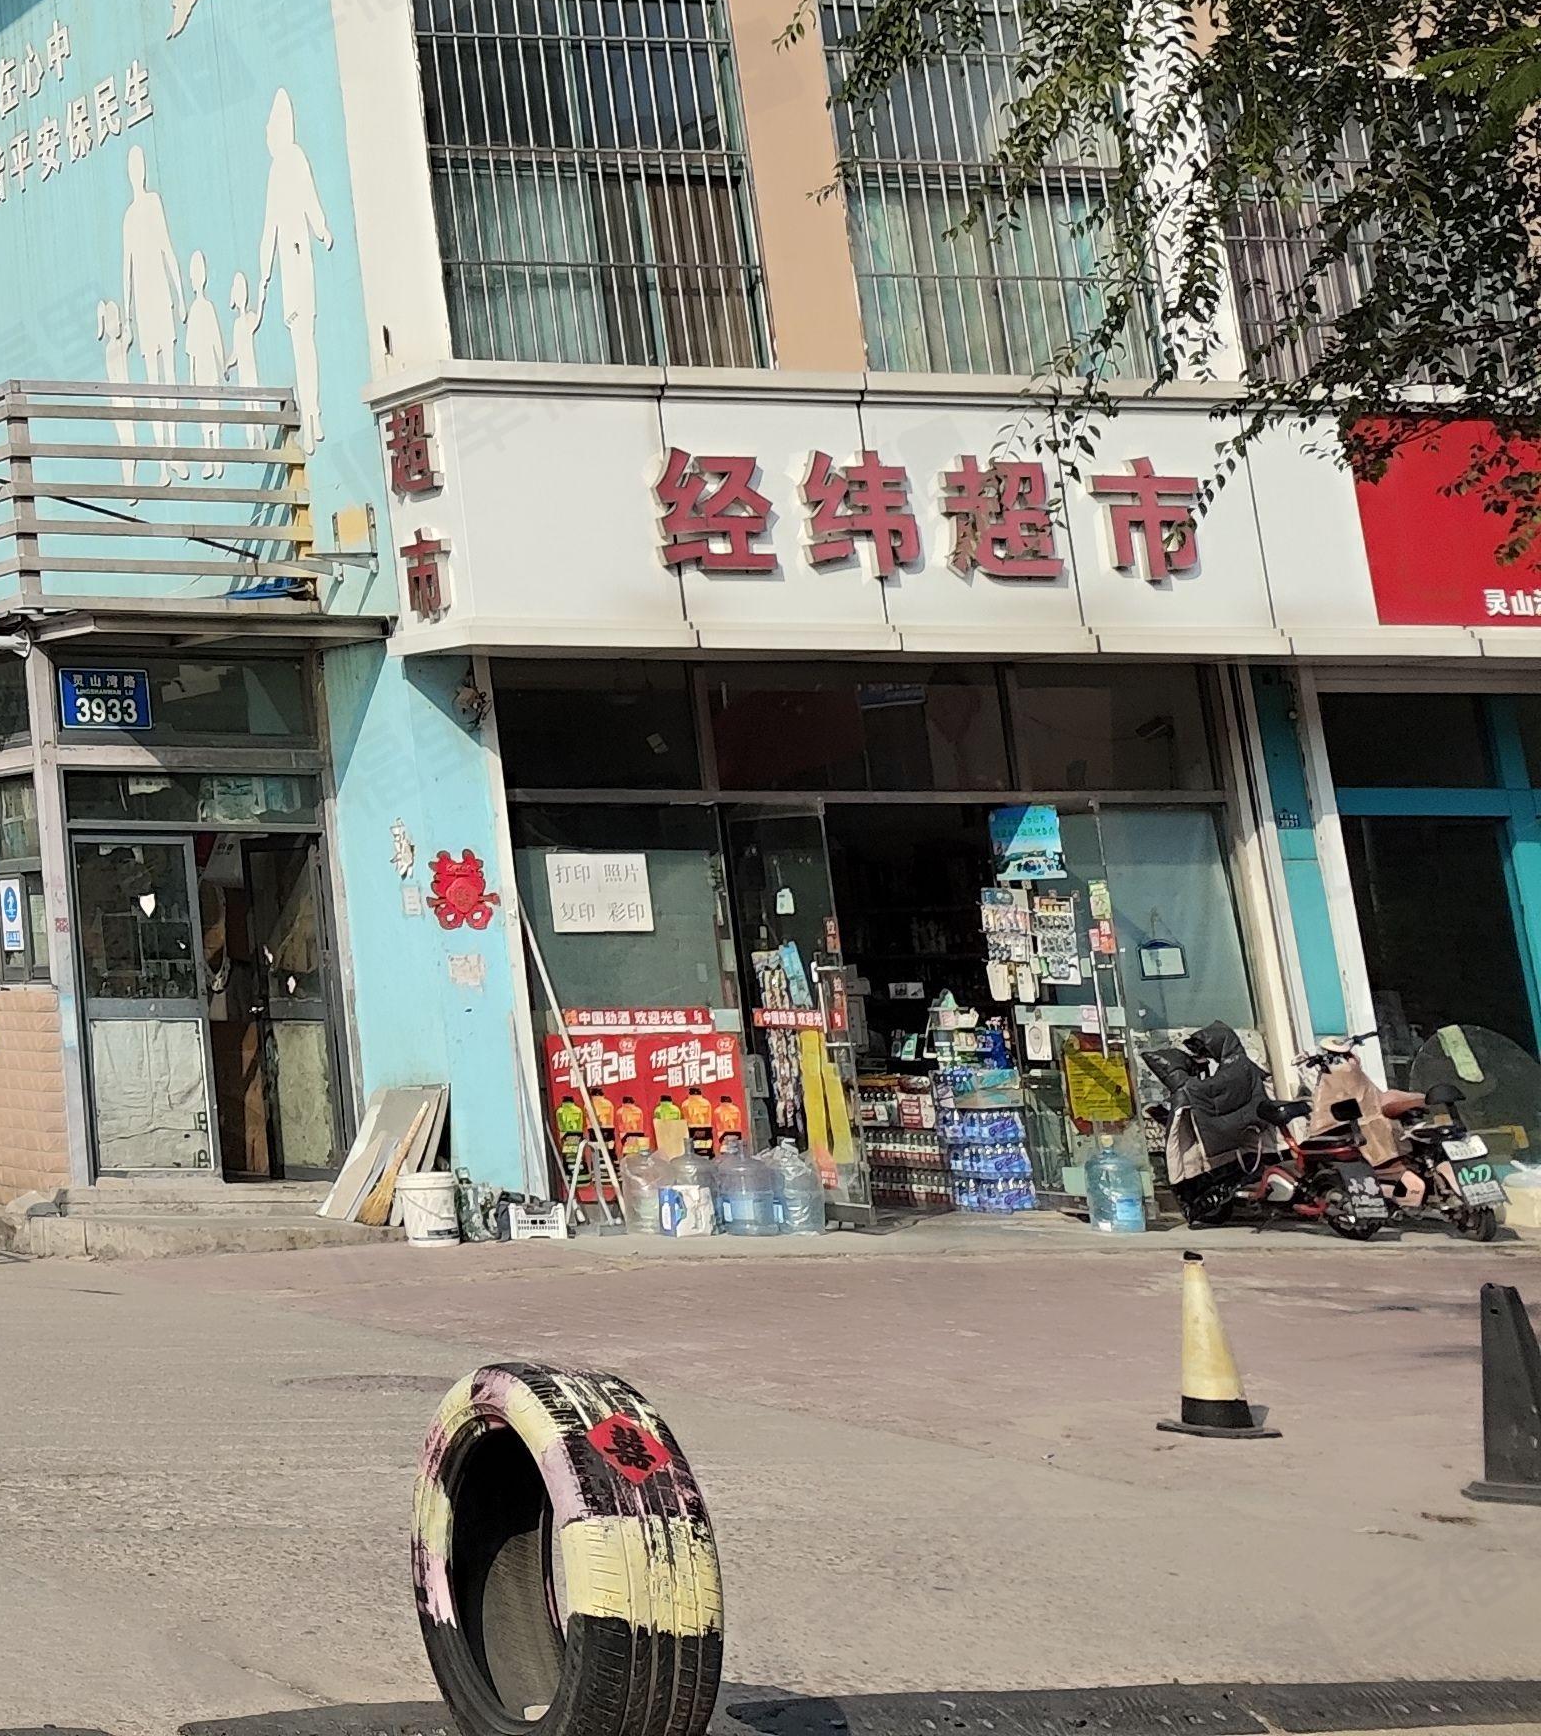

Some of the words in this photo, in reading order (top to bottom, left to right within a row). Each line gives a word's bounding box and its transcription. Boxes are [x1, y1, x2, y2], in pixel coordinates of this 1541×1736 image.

[386, 403, 451, 623] 超市
[652, 445, 1201, 582] 经纬超市
[76, 698, 137, 723] 3933
[555, 864, 591, 884] 打印
[603, 864, 639, 882] 照片
[560, 902, 595, 922] 复印
[608, 902, 645, 922] 彩印
[578, 1010, 630, 1025] 中国劲酒
[635, 1011, 686, 1025] 欢迎光临
[652, 1051, 734, 1088] 一瓶顶2瓶
